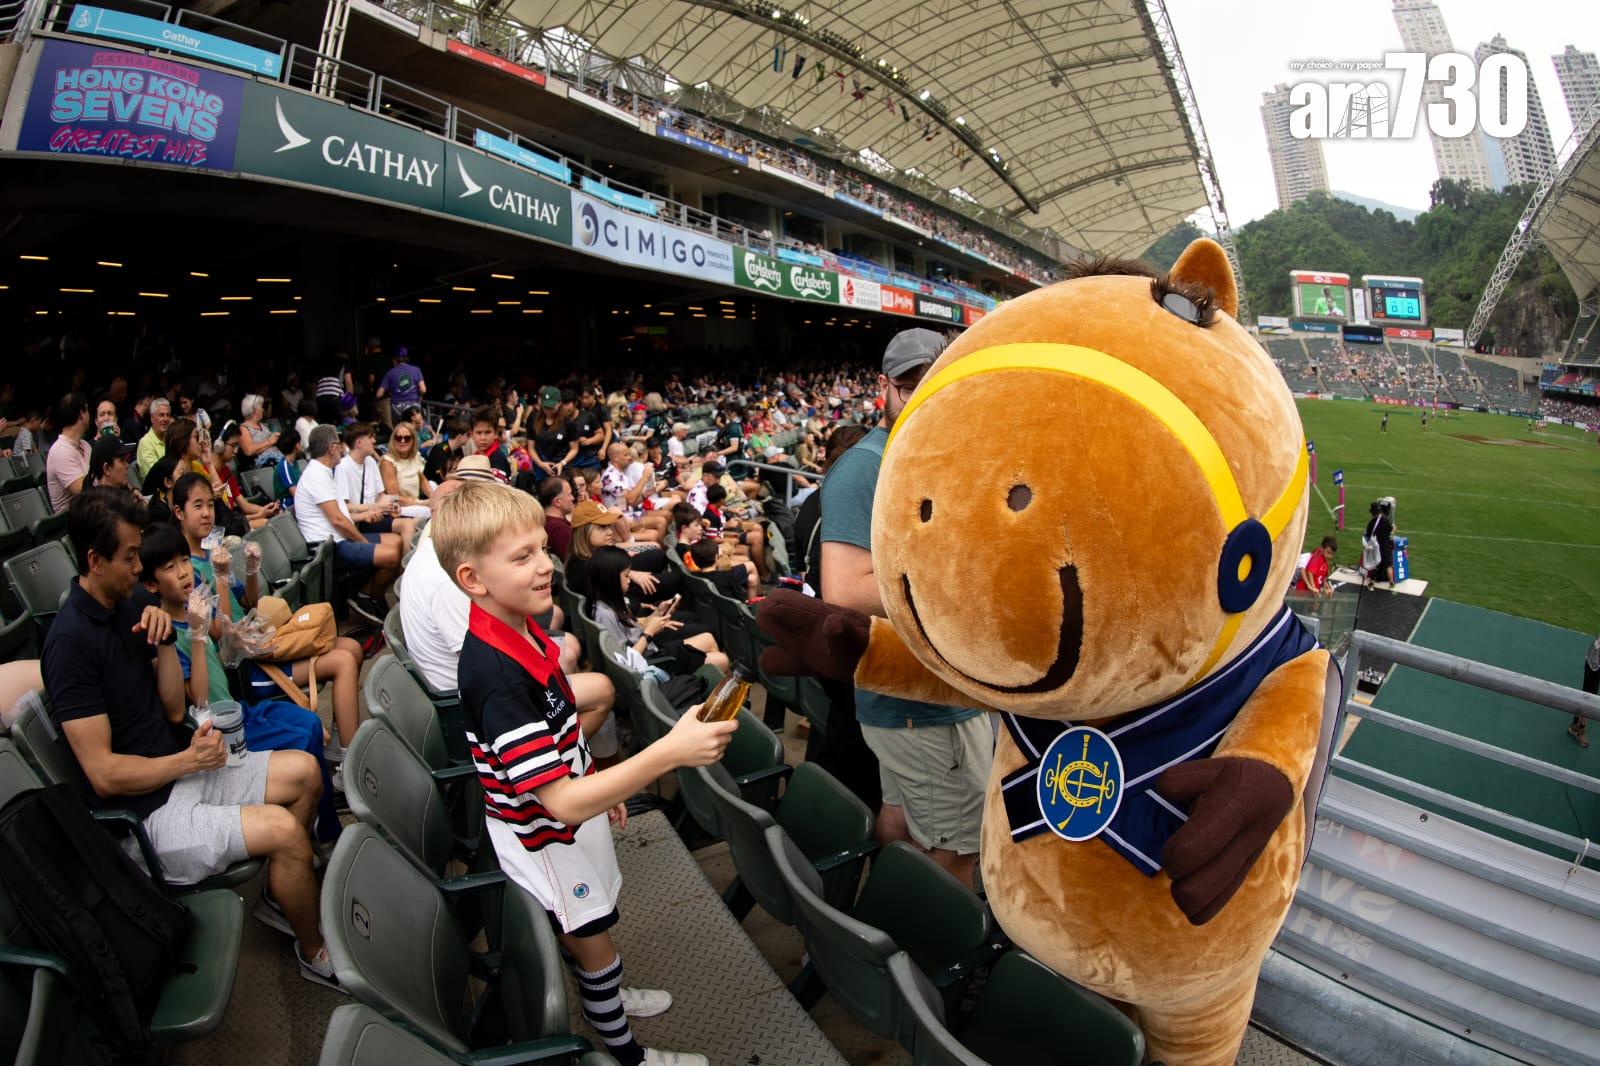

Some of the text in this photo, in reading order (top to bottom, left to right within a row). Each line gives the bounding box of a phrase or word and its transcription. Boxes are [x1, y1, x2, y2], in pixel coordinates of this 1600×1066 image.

[162, 29, 200, 48] Cathay
[55, 68, 223, 117] HONG KONG
[50, 90, 217, 142] SEVENS
[50, 125, 209, 166] GREATEST HITS
[321, 135, 439, 188] CATHAY
[488, 184, 561, 226] CATHAY
[604, 219, 706, 267] CIMIGO
[744, 252, 782, 290] Carlsberg
[790, 266, 832, 299] Carlsberg
